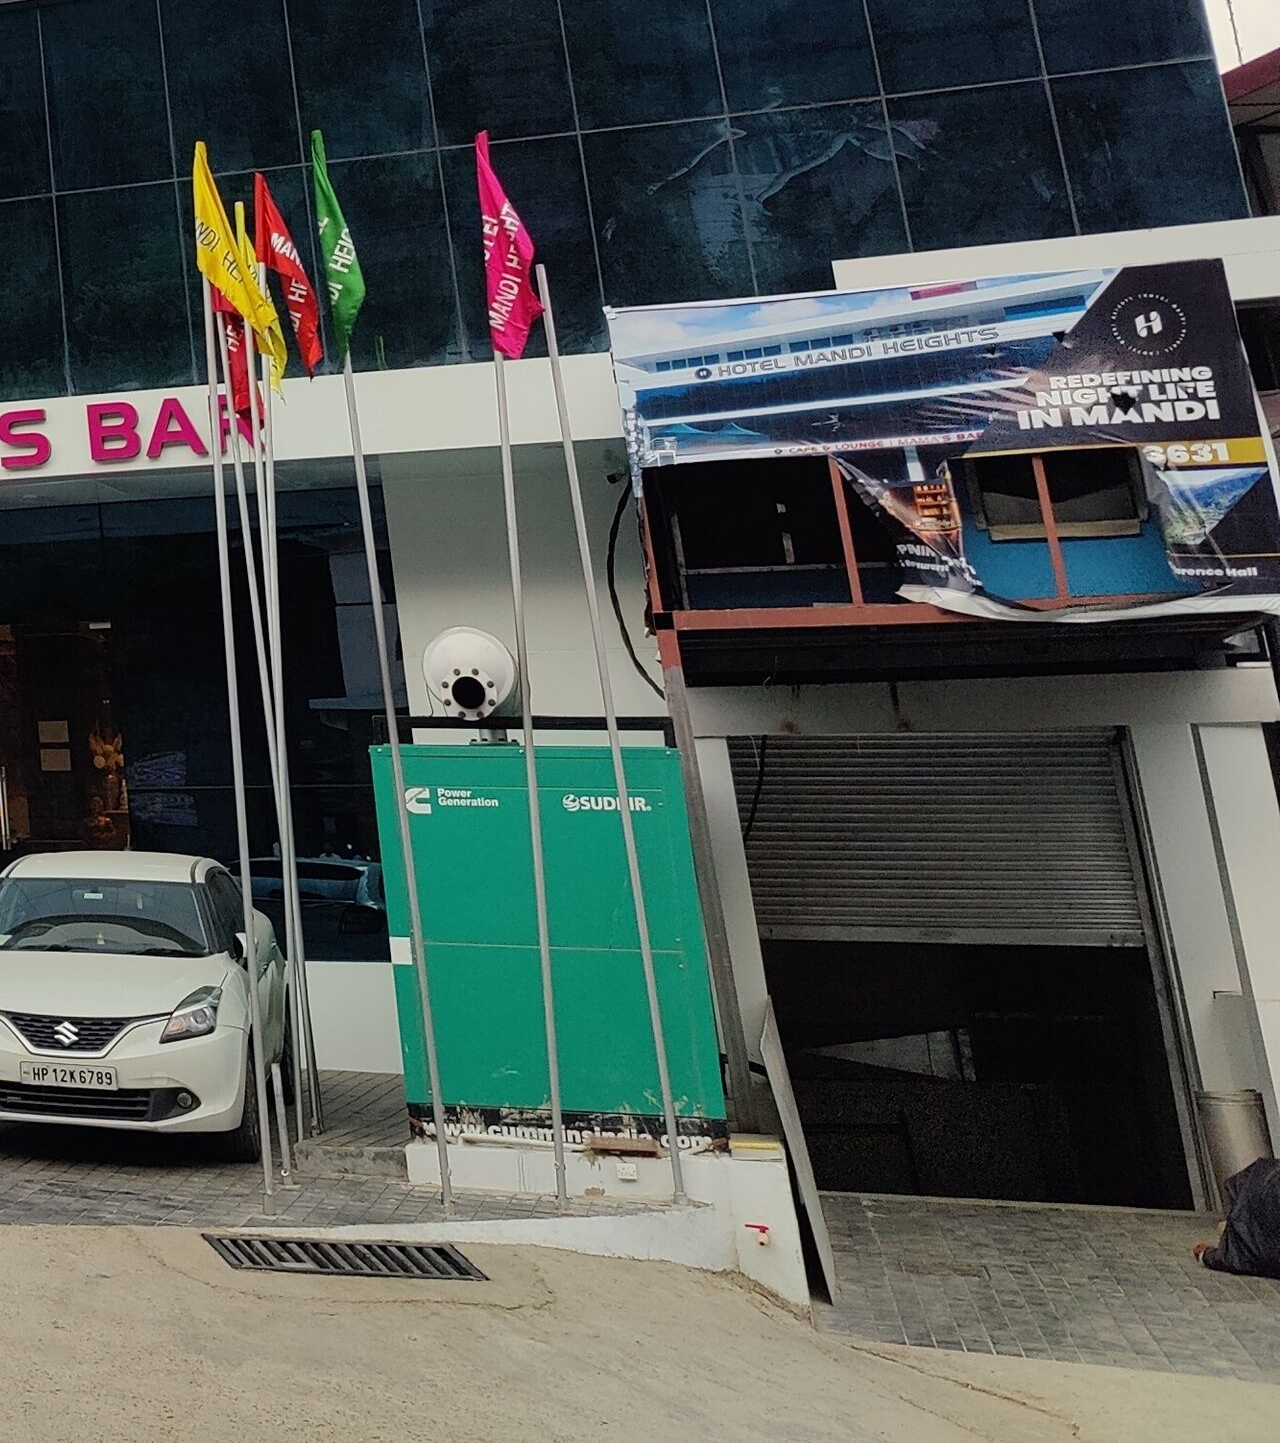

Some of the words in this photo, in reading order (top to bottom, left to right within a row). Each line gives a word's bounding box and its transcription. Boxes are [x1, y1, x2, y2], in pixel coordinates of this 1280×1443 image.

[488, 272, 522, 332] MANDI
[717, 358, 787, 378] HOTEL
[793, 344, 874, 367] MANDI
[882, 326, 1000, 356] HEIGHTS
[1048, 365, 1213, 389] REDEFINING
[1148, 380, 1217, 402] LIFE
[1017, 408, 1064, 430] IN
[1070, 398, 1221, 426] MANDI
[1225, 566, 1258, 577] Hall
[437, 788, 472, 799] Power
[438, 796, 499, 808] Generation
